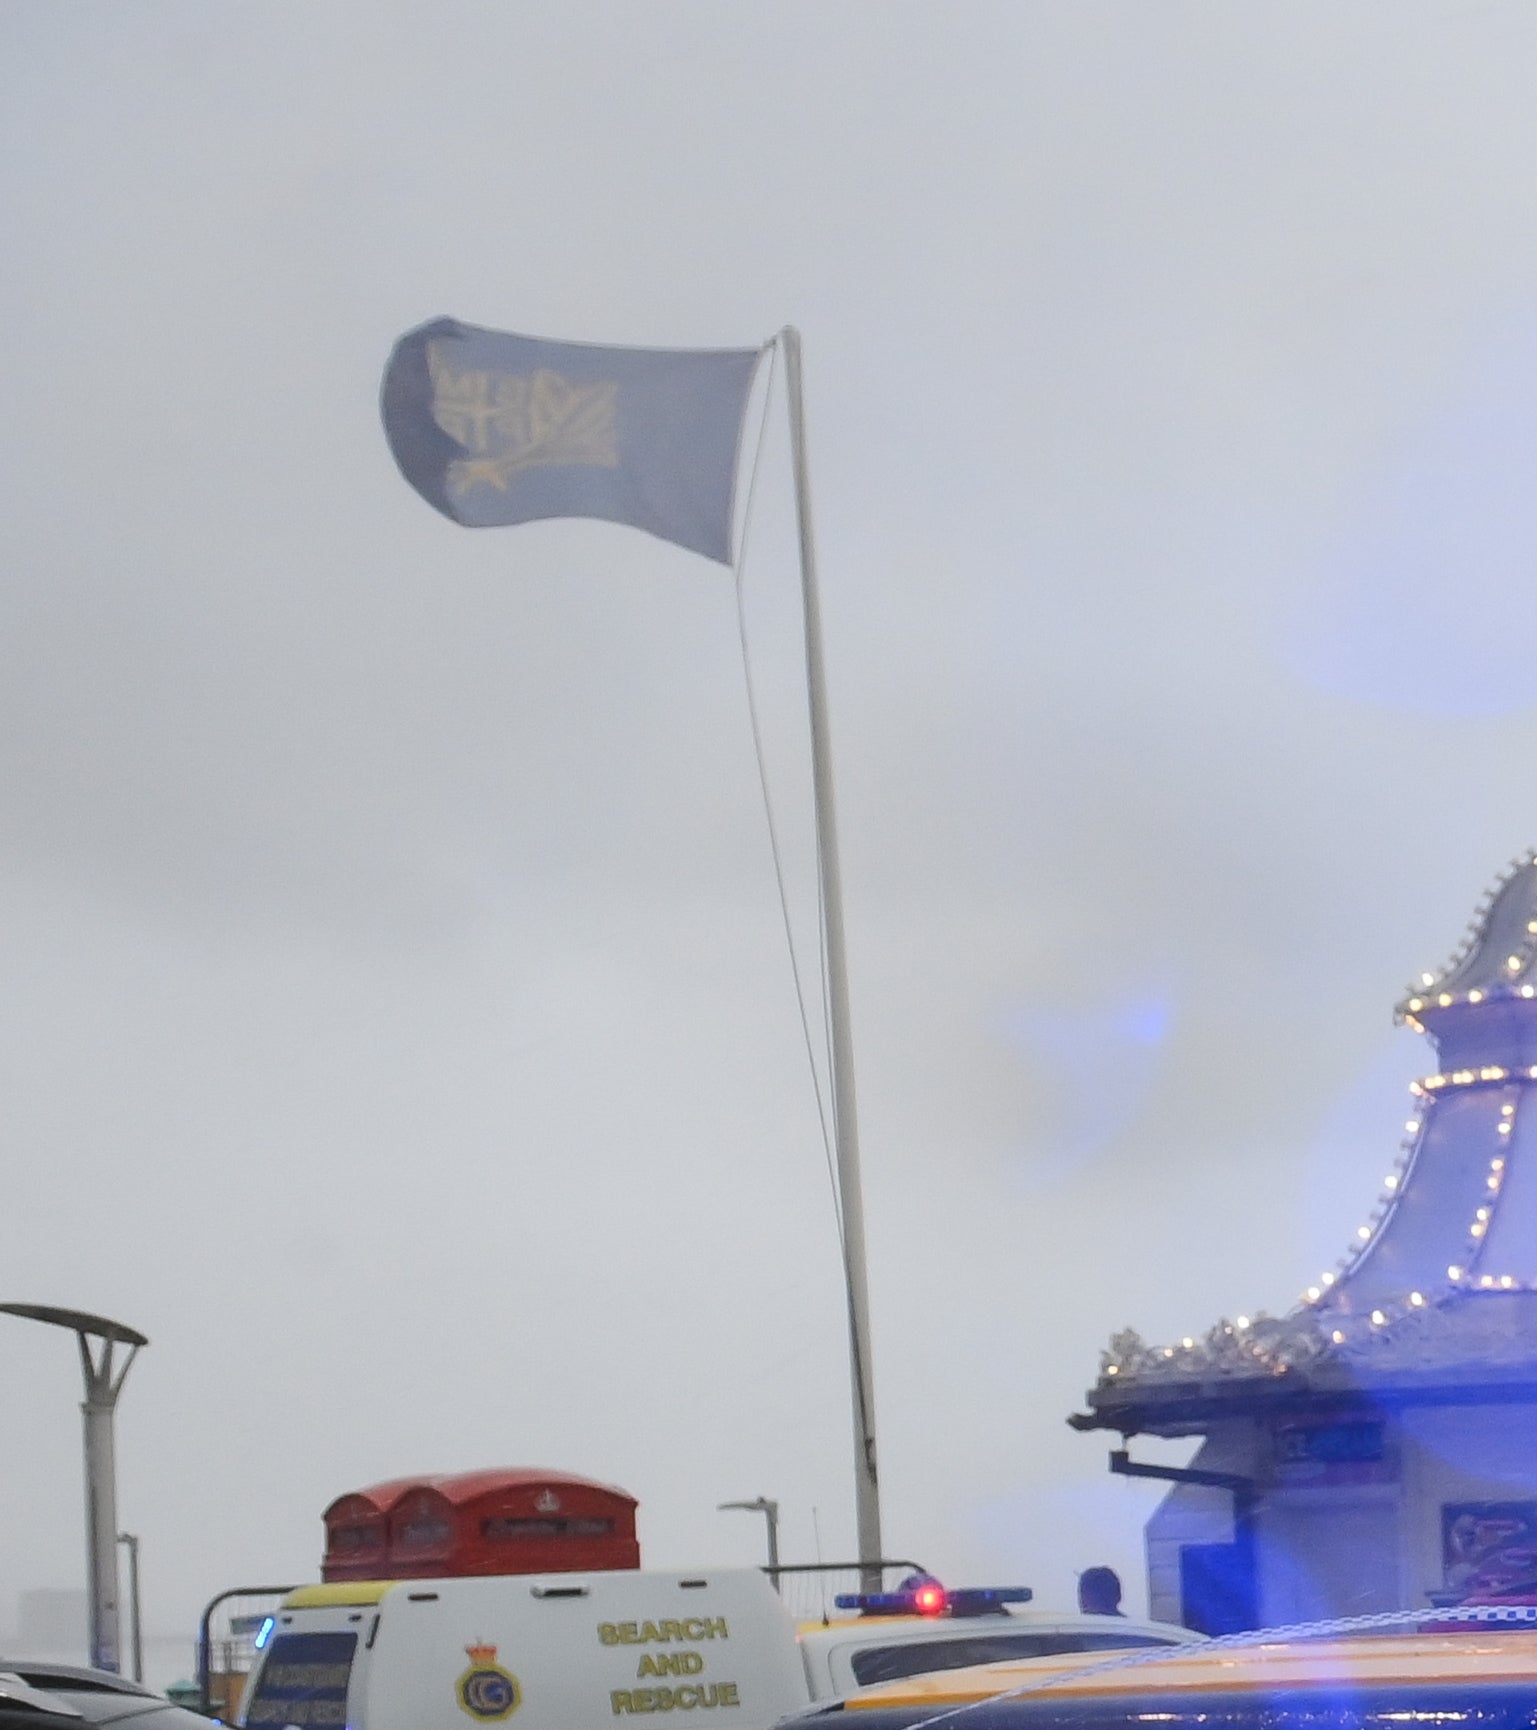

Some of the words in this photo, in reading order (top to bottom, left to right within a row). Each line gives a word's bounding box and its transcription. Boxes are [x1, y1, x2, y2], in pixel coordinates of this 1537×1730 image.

[597, 1615, 729, 1646] SEARCH
[637, 1651, 704, 1678] AND
[609, 1681, 741, 1716] RESCUE
